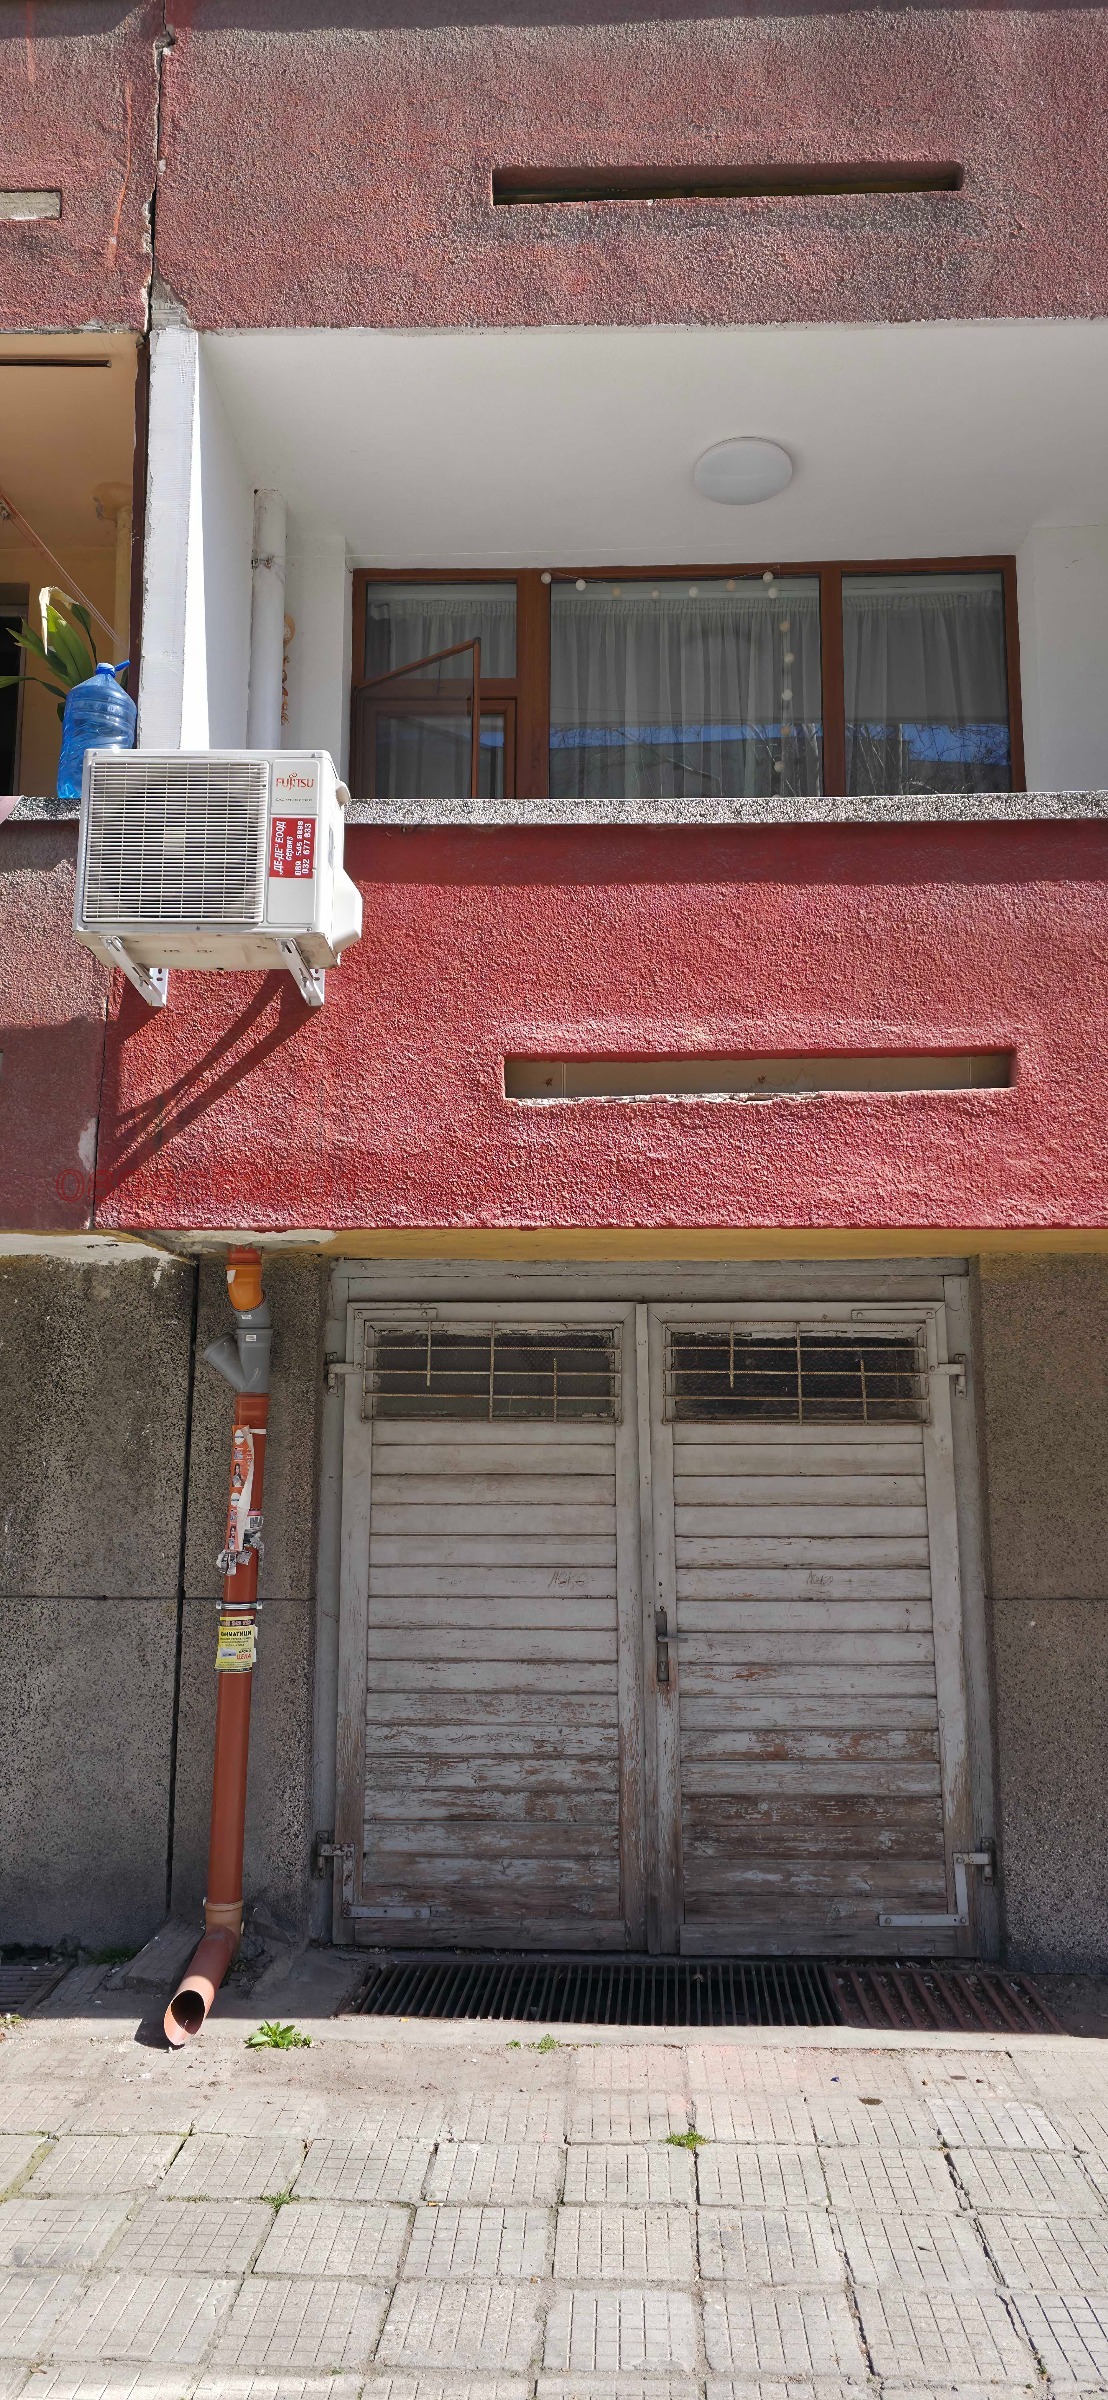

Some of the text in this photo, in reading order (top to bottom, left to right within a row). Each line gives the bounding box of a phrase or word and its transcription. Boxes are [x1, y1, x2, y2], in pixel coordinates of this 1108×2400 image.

[275, 772, 314, 790] FUJITSU
[275, 821, 286, 843] ЕООД
[302, 840, 310, 854] 677
[302, 858, 310, 874] 032
